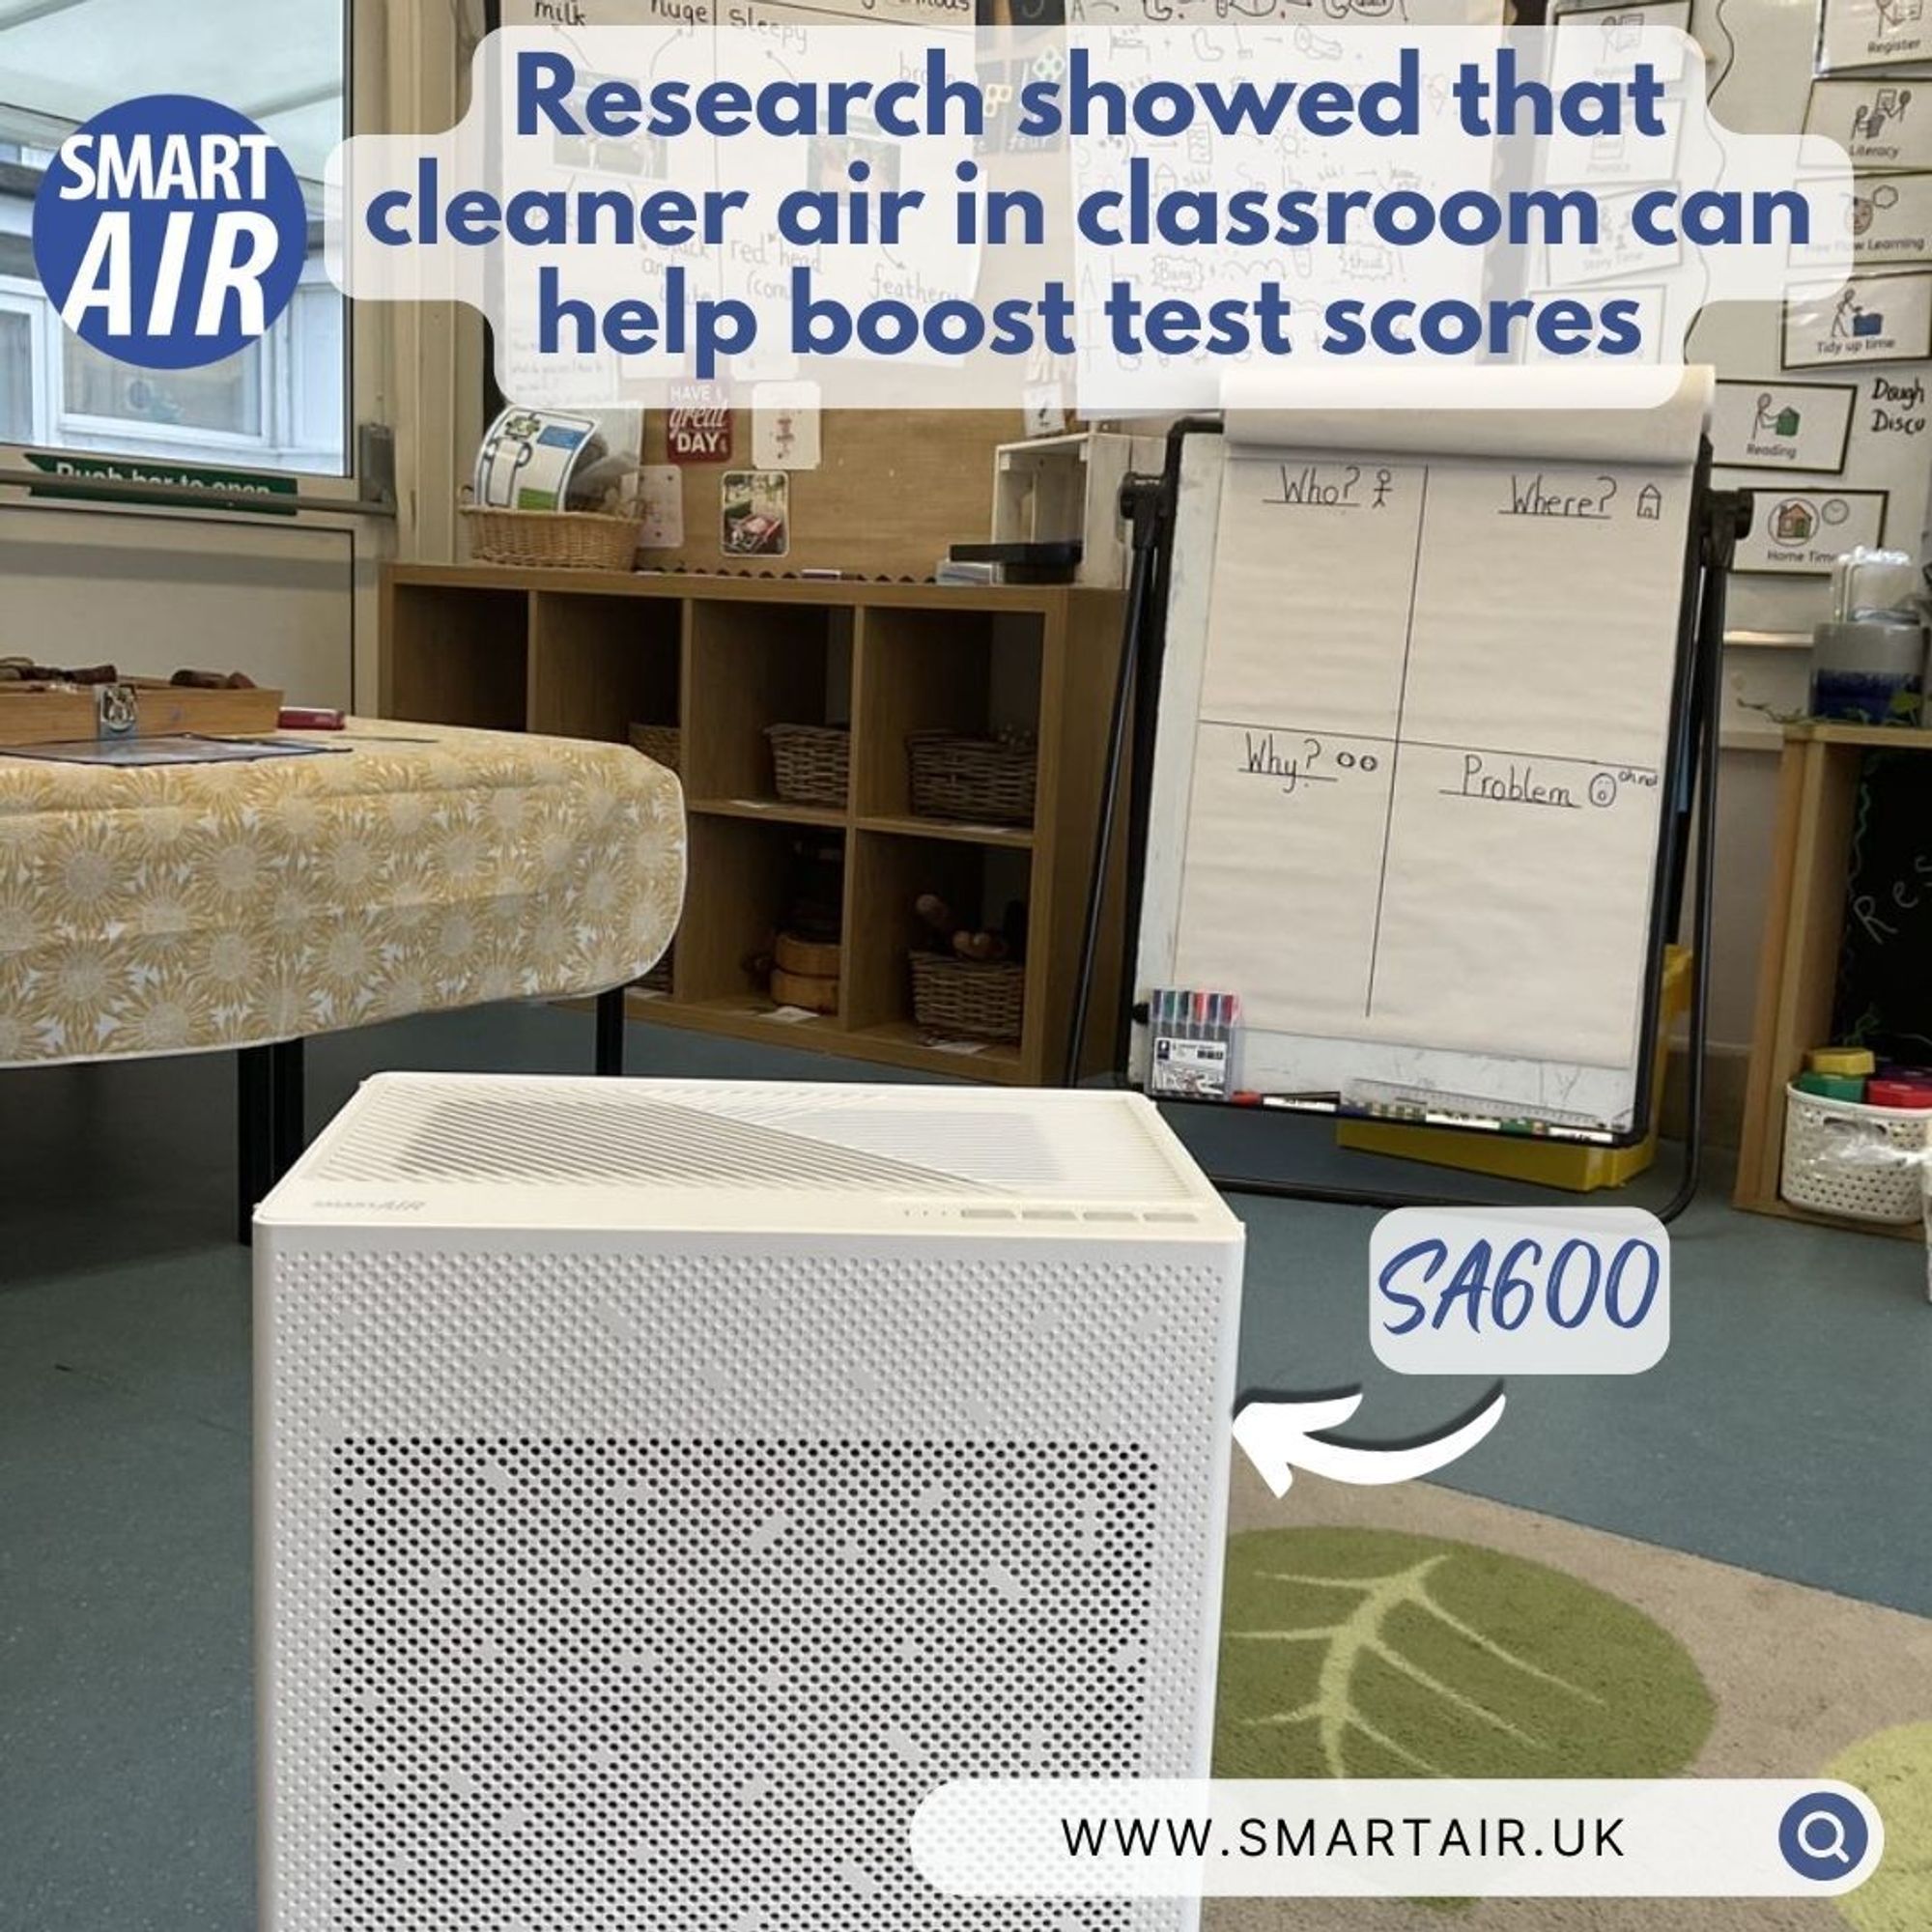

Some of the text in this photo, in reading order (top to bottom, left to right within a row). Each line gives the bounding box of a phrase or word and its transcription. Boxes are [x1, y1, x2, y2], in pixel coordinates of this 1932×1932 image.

[535, 1, 586, 26] milk
[1867, 39, 1921, 53] Register
[1848, 144, 1899, 160] Literacy
[1867, 237, 1924, 253] Learning
[1817, 338, 1895, 355] Tidy up time
[670, 385, 711, 401] HAVE
[1871, 377, 1925, 411] Dough
[677, 432, 720, 453] DAY
[1747, 443, 1798, 460] Reading
[1282, 465, 1361, 506] Who?
[1513, 474, 1617, 518] Where?
[1767, 550, 1805, 564] Home
[1246, 731, 1321, 793] Why?
[1463, 753, 1576, 808] Problem
